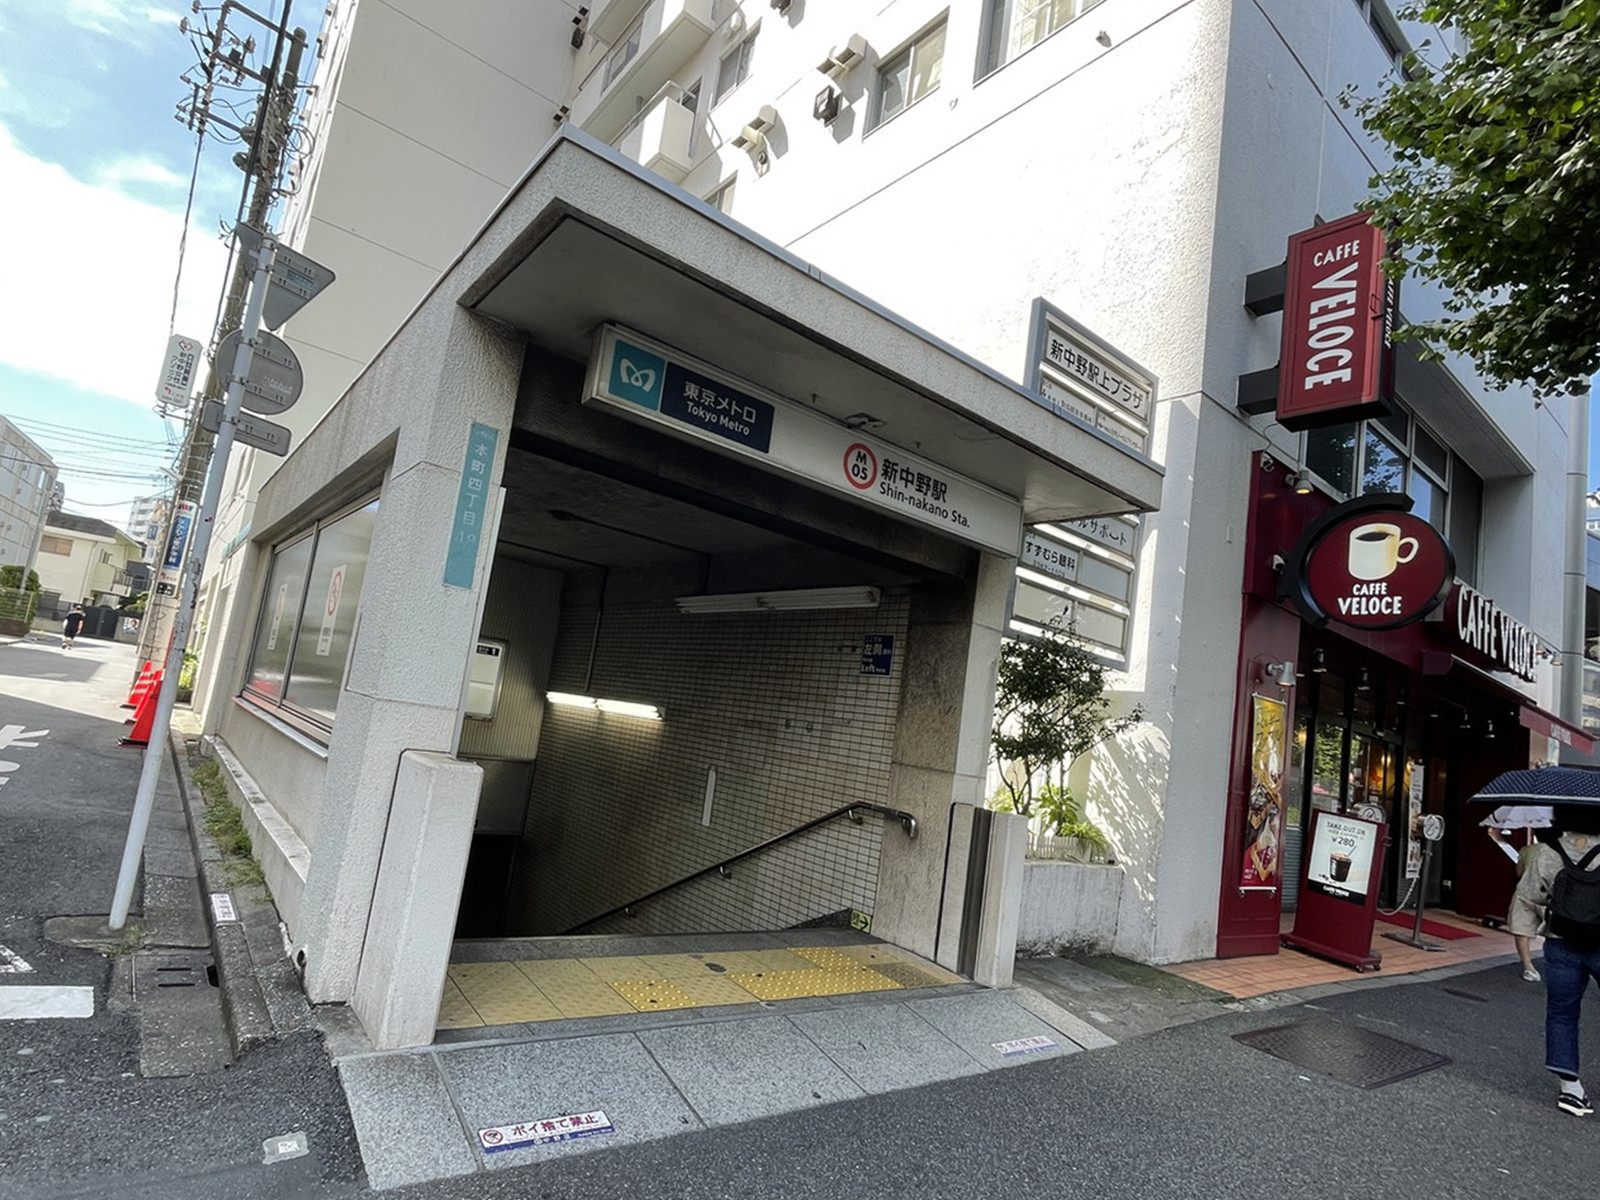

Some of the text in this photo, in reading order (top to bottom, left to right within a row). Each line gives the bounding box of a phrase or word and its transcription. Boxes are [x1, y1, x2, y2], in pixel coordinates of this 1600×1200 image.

[1313, 239, 1360, 268] CAFFE
[1304, 262, 1360, 390] VELOCE
[1050, 338, 1144, 409] 新中野駅上プラザ
[683, 381, 757, 424] 東京メトロ
[687, 401, 750, 436] Tokyo Metro
[851, 464, 868, 481] 05
[855, 450, 868, 465] M
[881, 458, 948, 503] 新中野駅
[879, 482, 971, 528] Shin-nakano Sta.
[1352, 581, 1388, 596] CAFFE
[1337, 595, 1402, 616] VELOCE
[1458, 585, 1538, 683] CAFFE VELOCE
[1326, 821, 1342, 830] TAKE
[512, 1114, 599, 1136] ポイ捨て禁止
